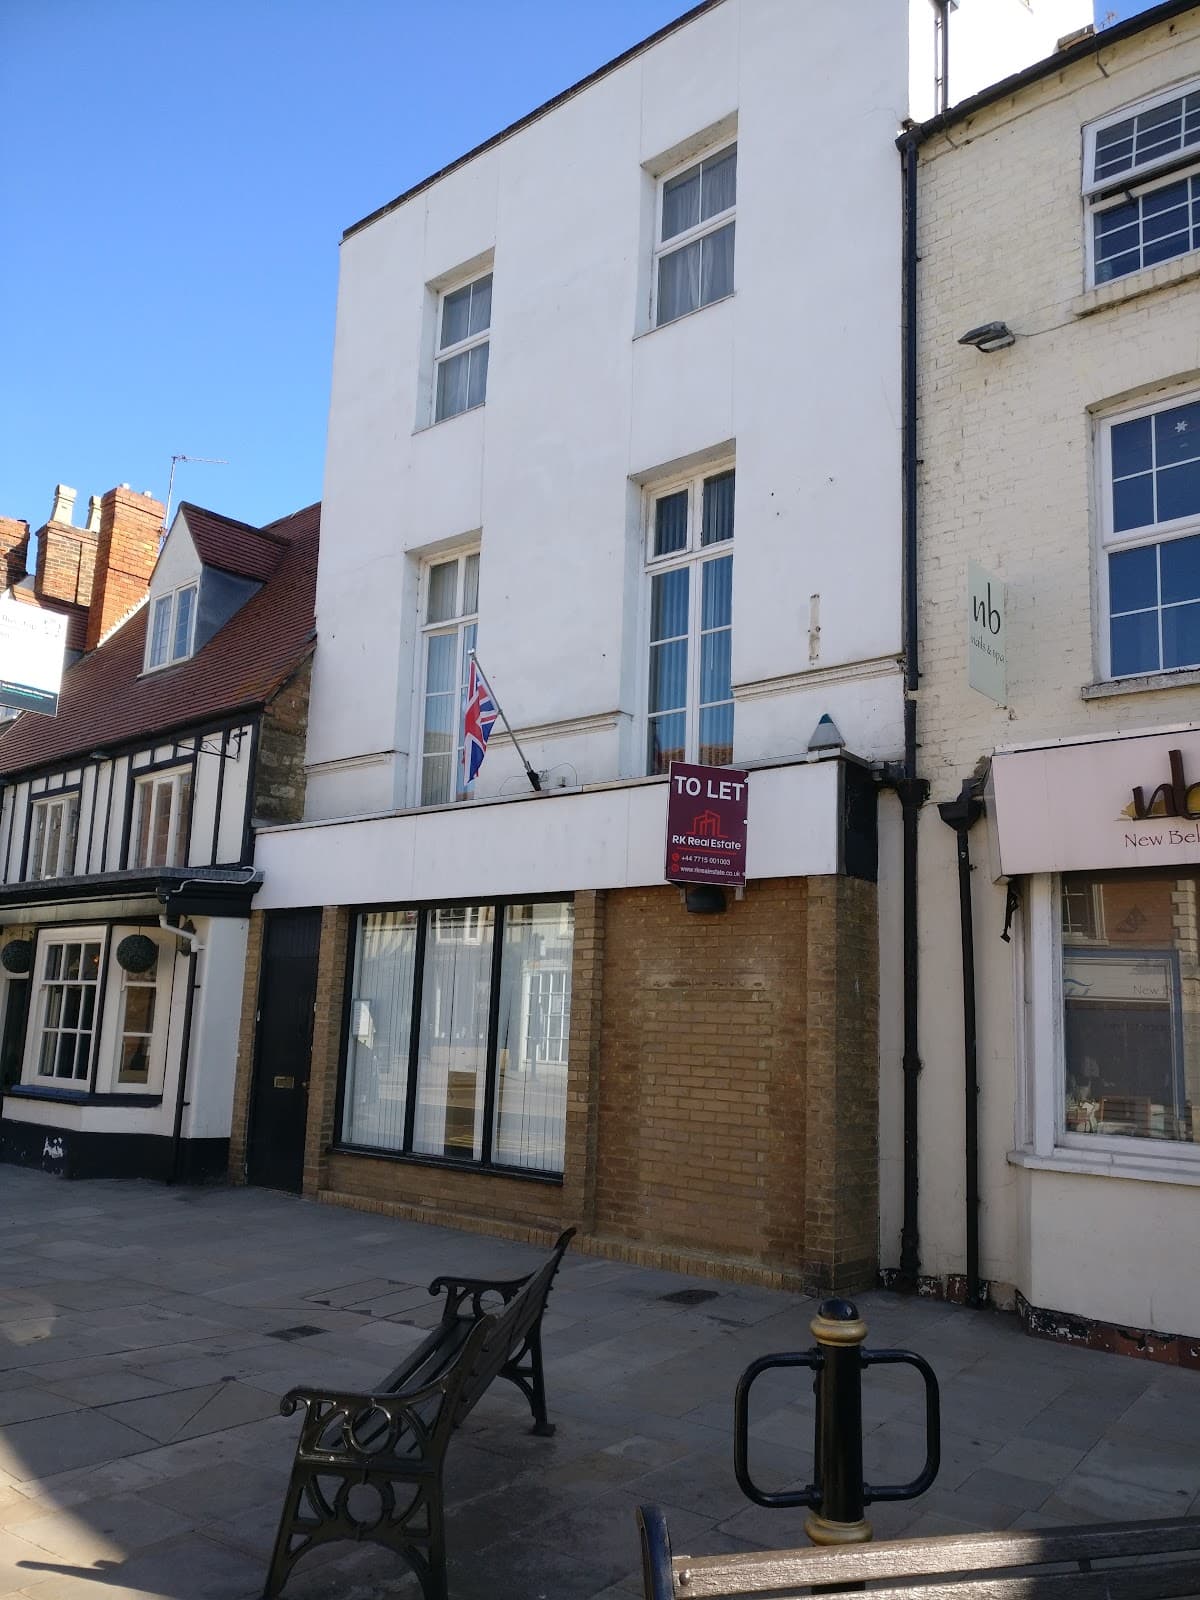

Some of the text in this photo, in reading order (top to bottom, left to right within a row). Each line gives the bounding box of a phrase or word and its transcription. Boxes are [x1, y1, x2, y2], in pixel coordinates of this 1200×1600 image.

[674, 775, 745, 801] TO LET
[672, 835, 742, 850] RK Real Estate
[1124, 833, 1163, 848] New
